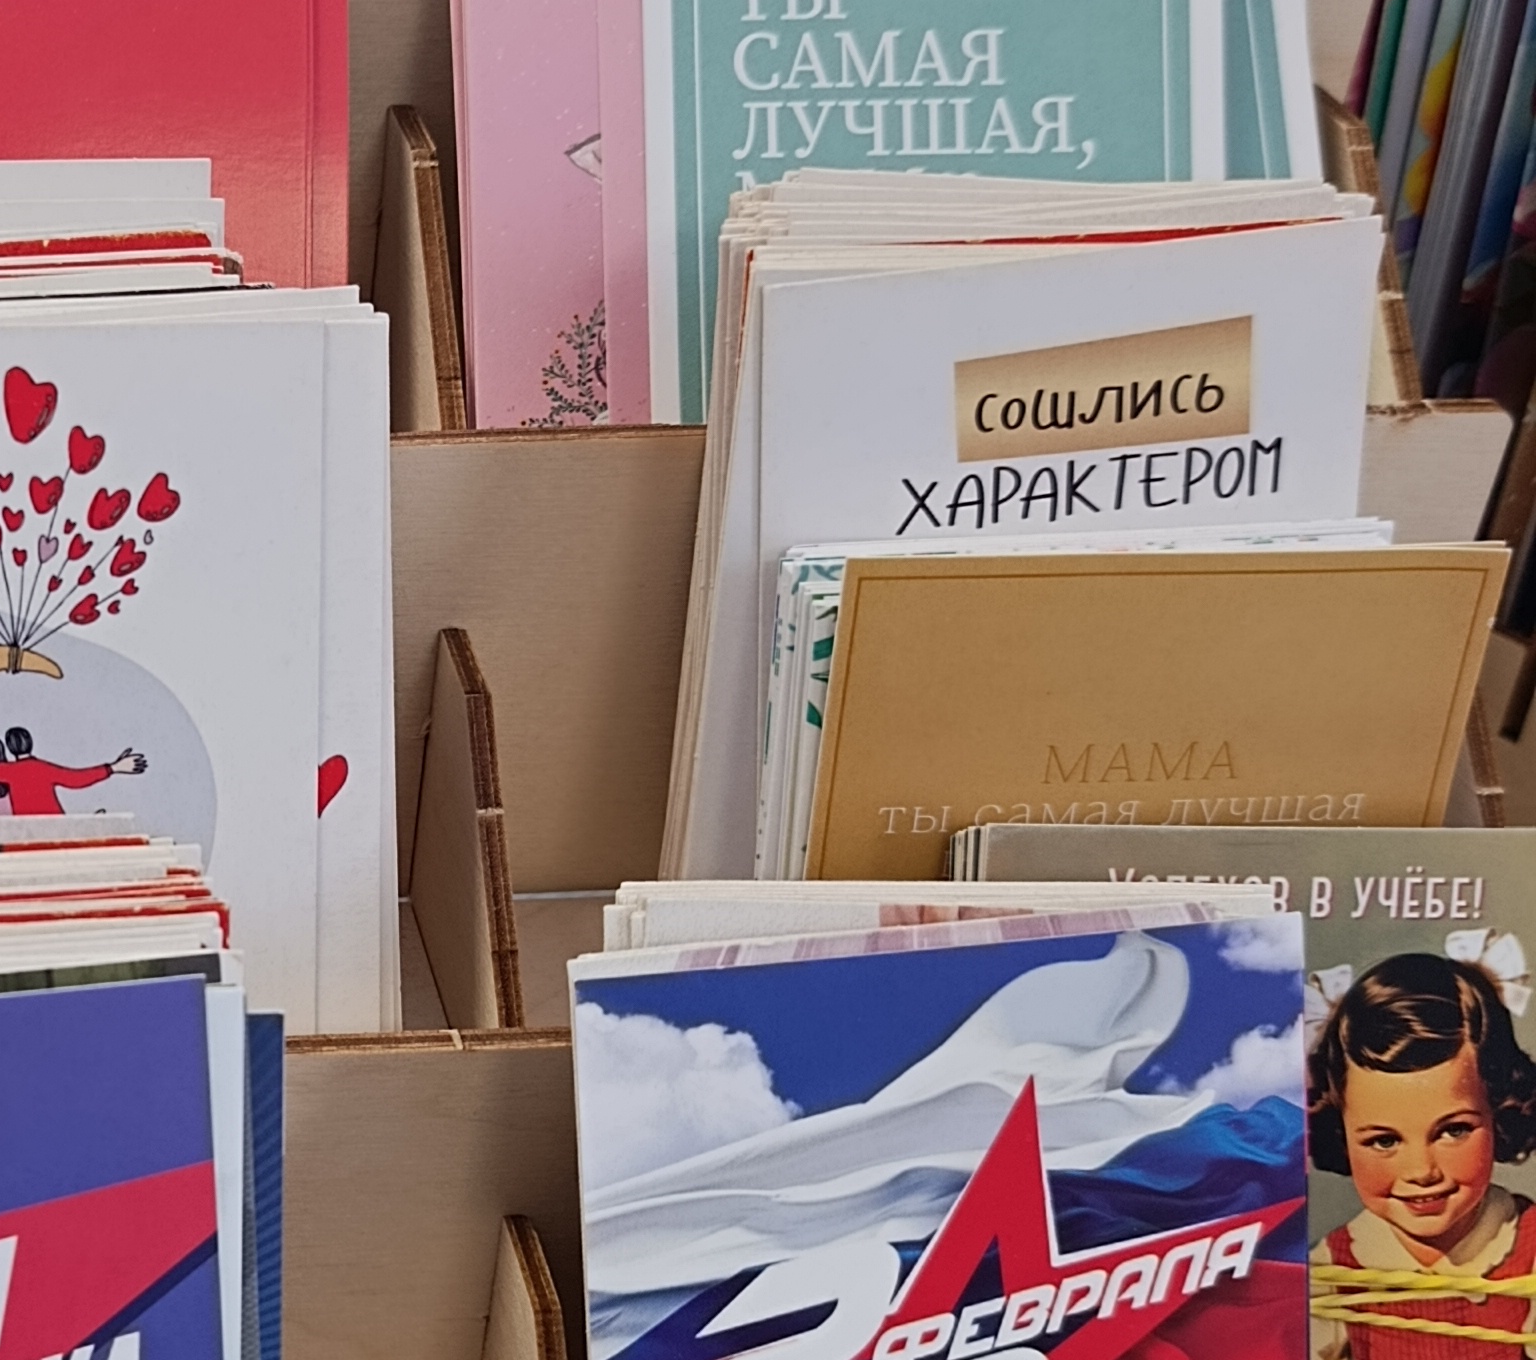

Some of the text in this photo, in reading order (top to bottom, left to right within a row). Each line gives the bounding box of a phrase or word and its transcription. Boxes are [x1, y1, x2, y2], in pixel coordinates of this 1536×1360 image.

[732, 27, 1007, 92] САМАЯ
[732, 95, 1097, 170] ЛУЧШАЯ,
[895, 436, 1284, 537] ХАРАКТЕРОМ
[1041, 740, 1240, 785] МАМА
[878, 805, 952, 835] ты
[1161, 792, 1367, 827] лучшая
[1350, 865, 1486, 920] УЧЁБЕ!
